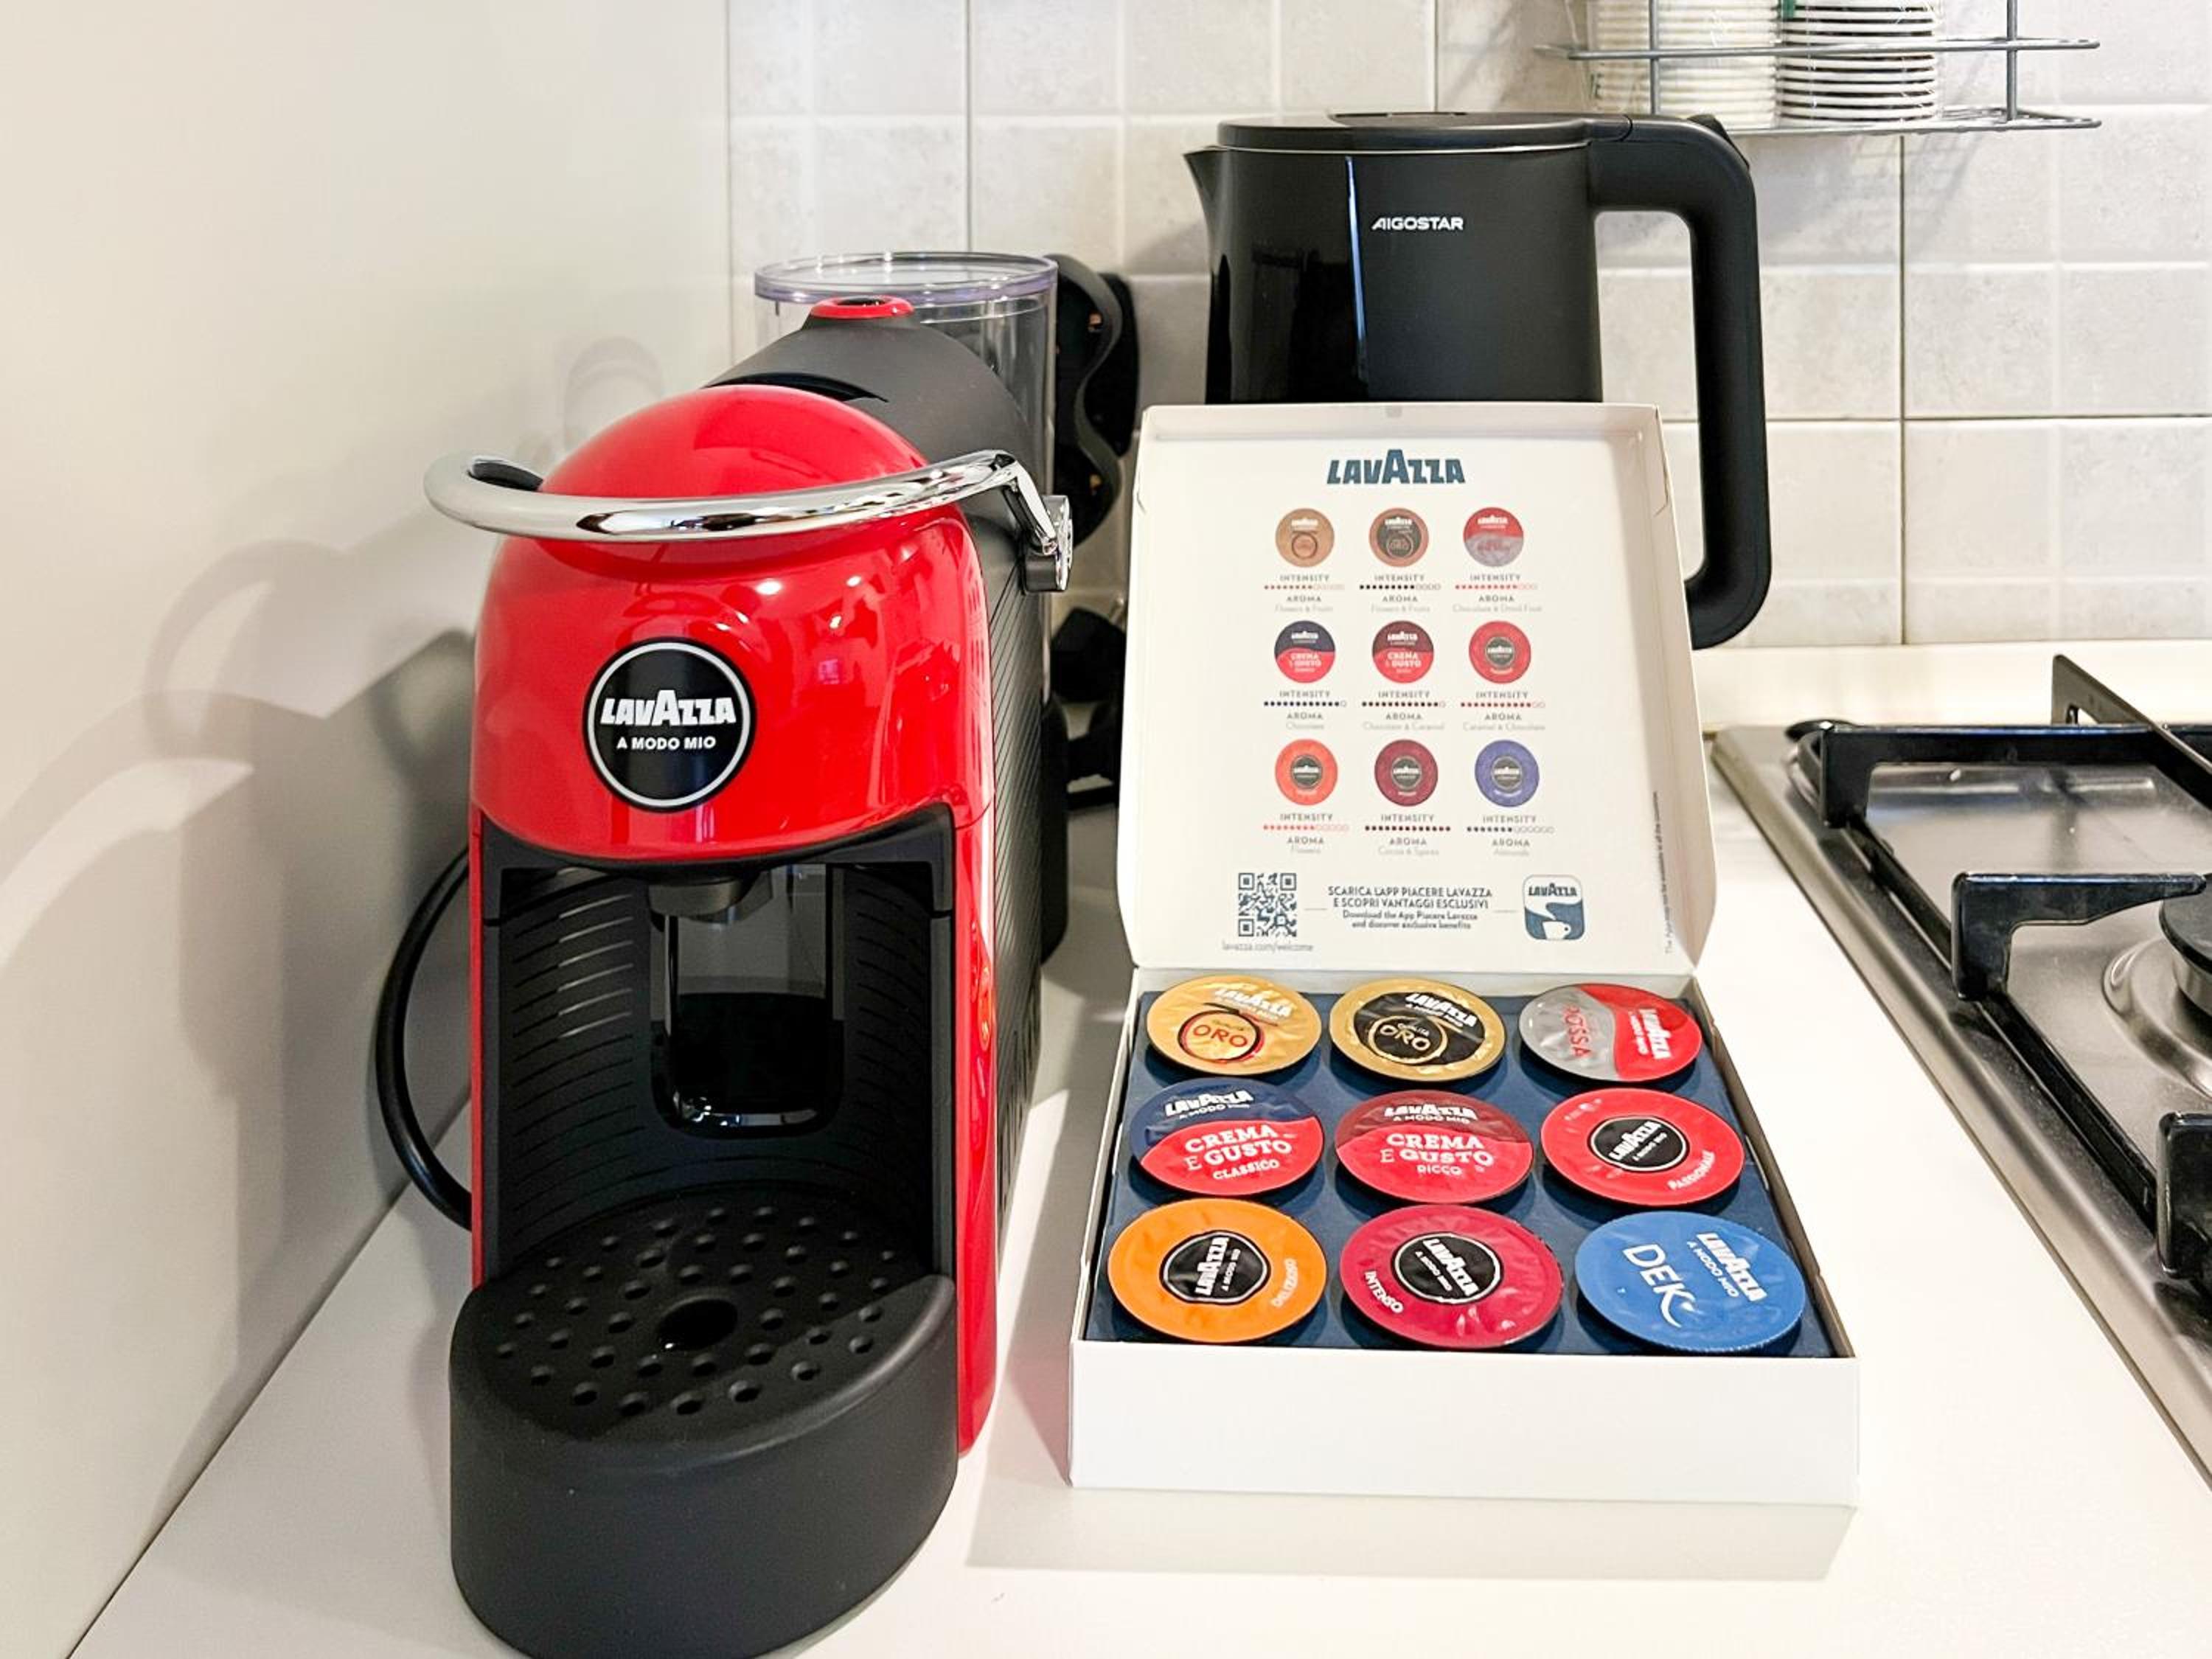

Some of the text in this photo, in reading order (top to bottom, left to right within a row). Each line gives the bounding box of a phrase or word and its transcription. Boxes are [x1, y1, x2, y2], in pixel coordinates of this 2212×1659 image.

[1371, 217, 1464, 230] AIGOSTAR
[1326, 448, 1466, 484] LAVAZZA
[1280, 574, 1330, 582] INTENSITY
[1374, 574, 1425, 582] INTENSITY
[600, 689, 737, 726] LAVAZZA
[1385, 712, 1423, 720] AROMA
[616, 736, 716, 751] A MODO MIO
[1381, 814, 1434, 822] INTENSITY
[1483, 815, 1537, 823] INTENSITY
[1287, 837, 1324, 845] AROMA
[1492, 838, 1530, 846] AROMA
[1328, 886, 1371, 896] SCARICA
[1402, 887, 1444, 897] PIACERE
[1447, 887, 1492, 897] LAVAZZA
[1528, 883, 1577, 897] LAVAZZA
[1333, 897, 1489, 909] E SCOPRI VANTAGGI ESCLUSIVI
[1343, 909, 1382, 919] Download
[1384, 910, 1396, 919] the
[1399, 911, 1414, 920] App
[1417, 911, 1445, 919] Piacere
[1352, 920, 1366, 928] and
[1402, 921, 1437, 929] exclusive
[1439, 921, 1471, 930] benefits
[1405, 993, 1478, 1027] LAVAZZA
[1193, 1024, 1248, 1047] ORO
[1380, 1024, 1431, 1051] ORO
[1165, 1090, 1254, 1116] LAVAZZA
[1189, 1104, 1226, 1116] MODO
[1384, 1104, 1478, 1121] LAVAZZA
[1446, 1116, 1471, 1124] MIO
[1185, 1124, 1279, 1153] CREMA
[1386, 1133, 1485, 1150] CREMA
[1608, 1121, 1662, 1161] LAVAZZA
[1184, 1139, 1293, 1172] E GUSTO
[1380, 1148, 1495, 1166] E GUSTO
[1212, 1158, 1281, 1179] CLASSICO
[1416, 1164, 1464, 1175] RICCO
[1194, 1237, 1230, 1296] LAVAZZA
[1422, 1238, 1480, 1297] LAVAZZA
[1695, 1248, 1723, 1276] MODO
[1697, 1233, 1768, 1302] LAVAZZA
[1364, 1270, 1404, 1314] INTENSO
[1622, 1244, 1696, 1328] DEK
